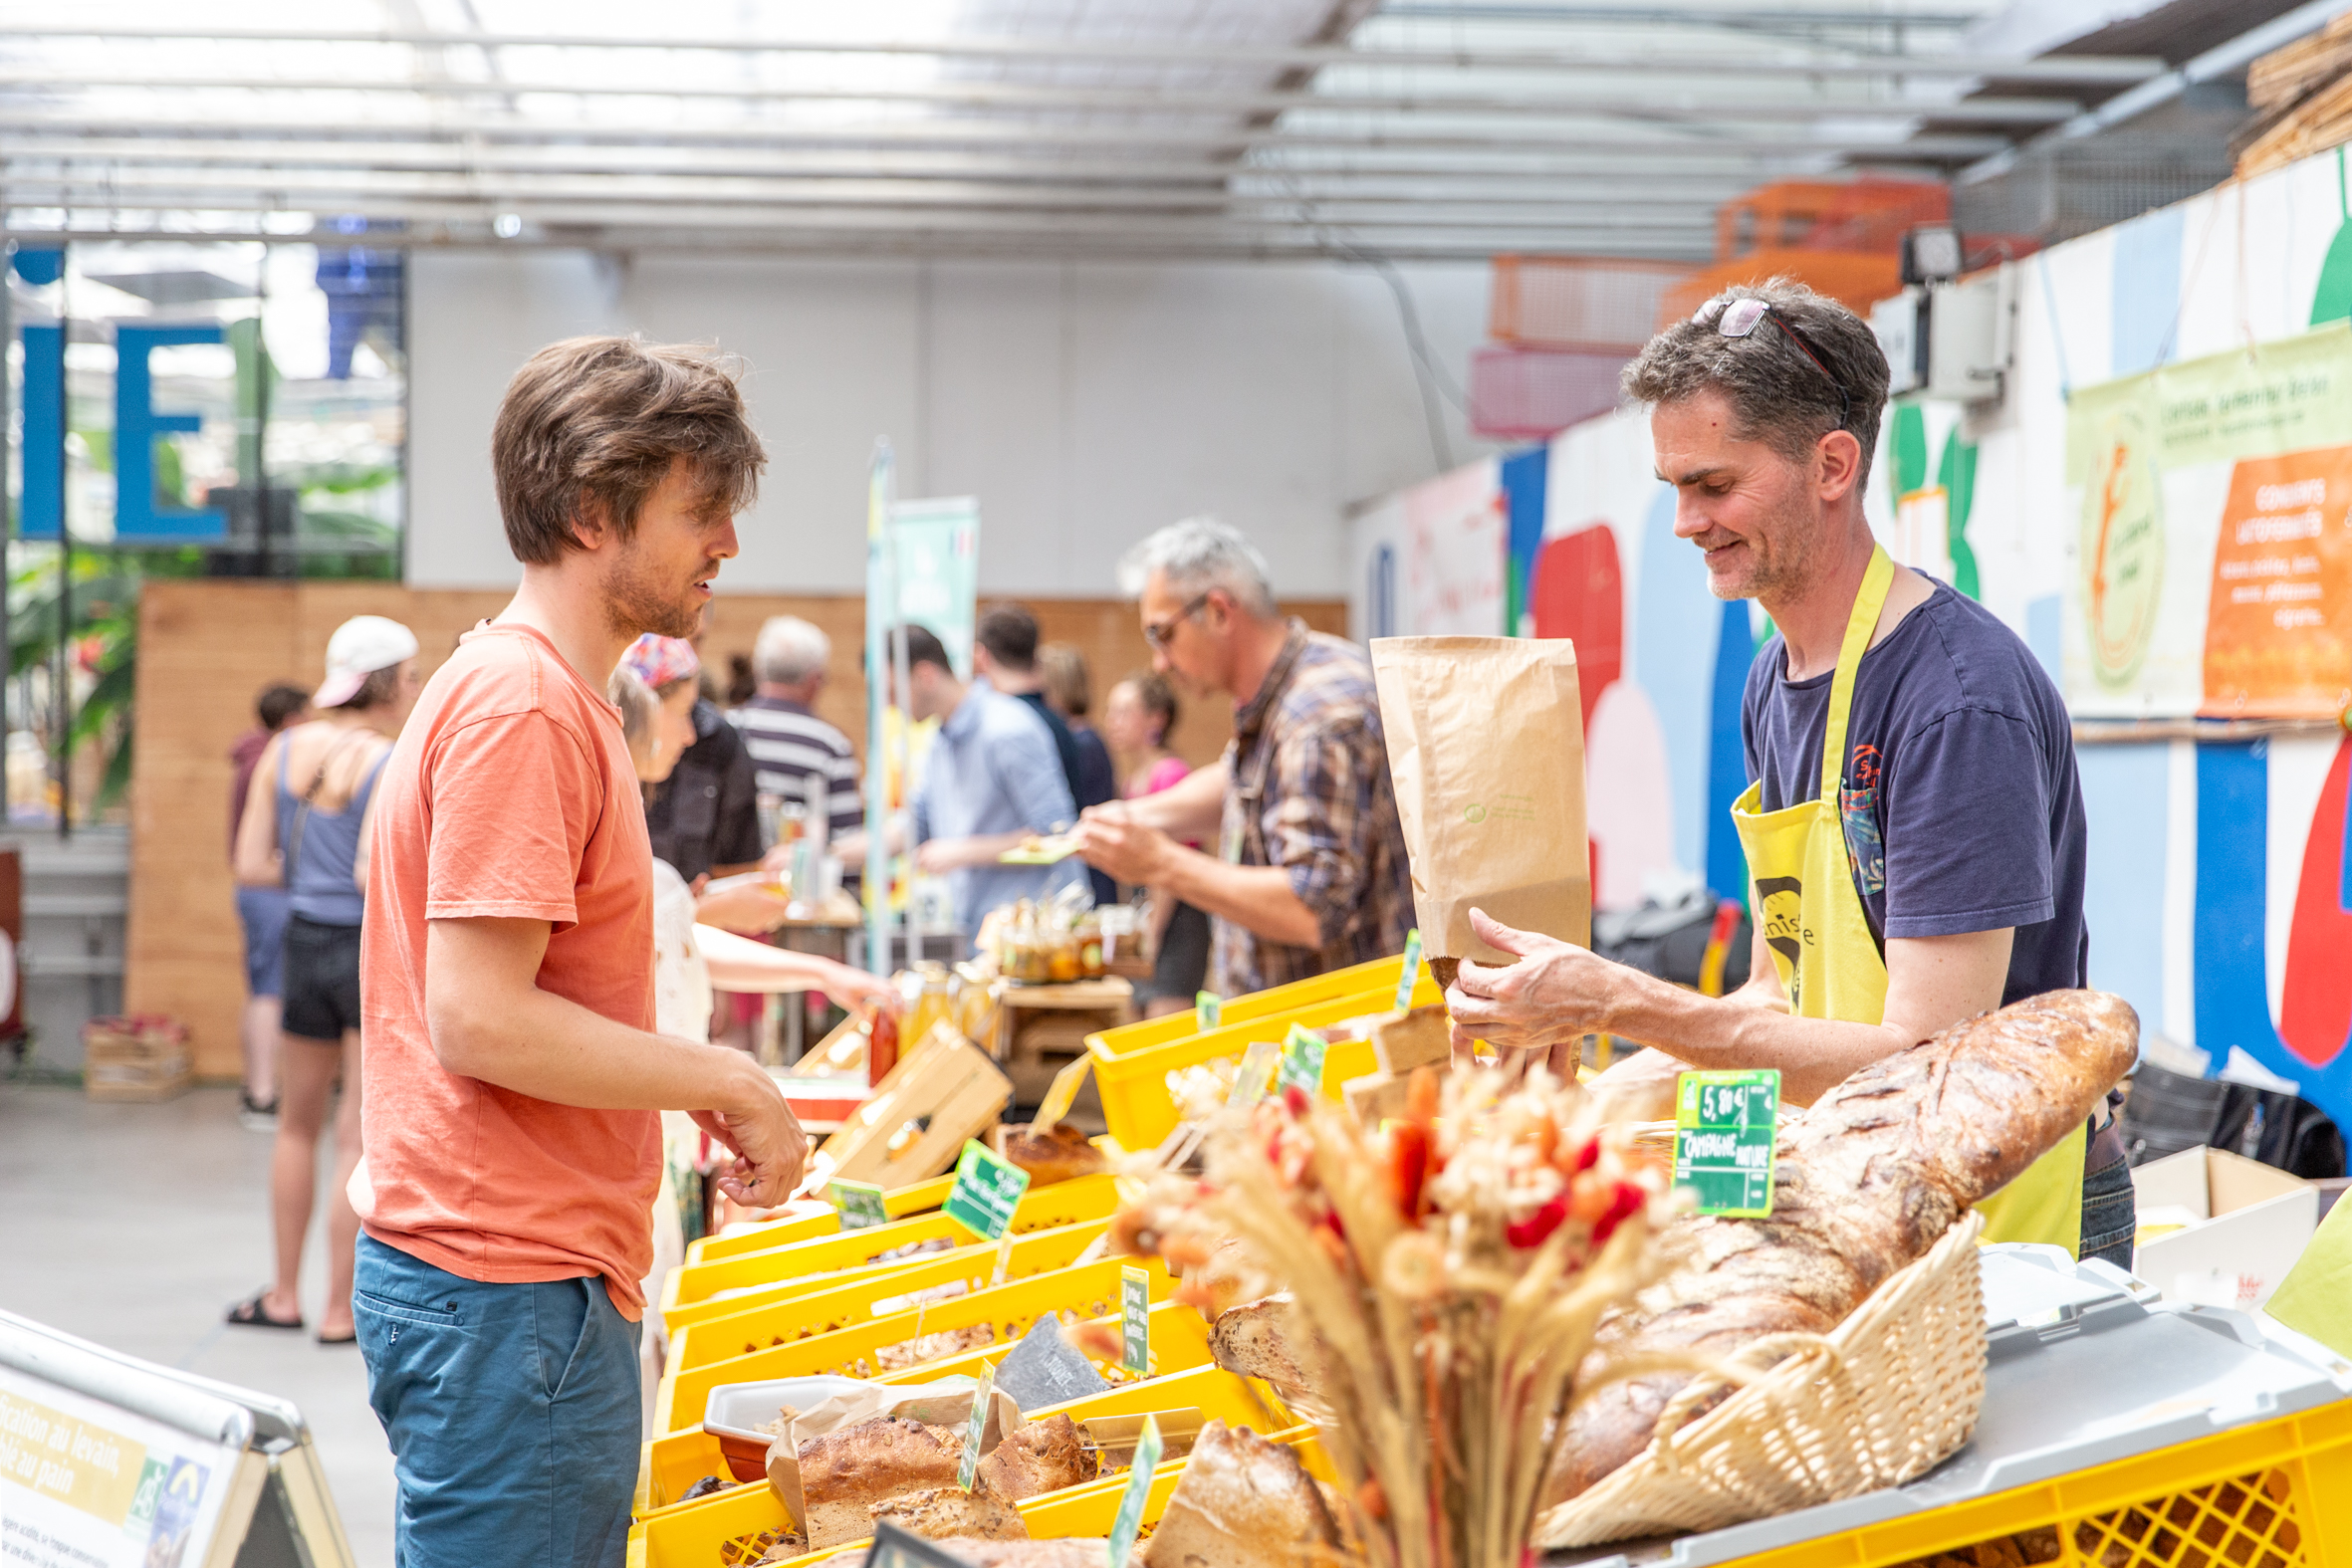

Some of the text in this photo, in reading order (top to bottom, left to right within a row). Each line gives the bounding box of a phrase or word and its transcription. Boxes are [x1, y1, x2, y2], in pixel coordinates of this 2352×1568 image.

[17, 1452, 38, 1479] au
[35, 1459, 75, 1494] pain
[50, 1424, 71, 1452] au
[72, 1426, 118, 1477] levain,
